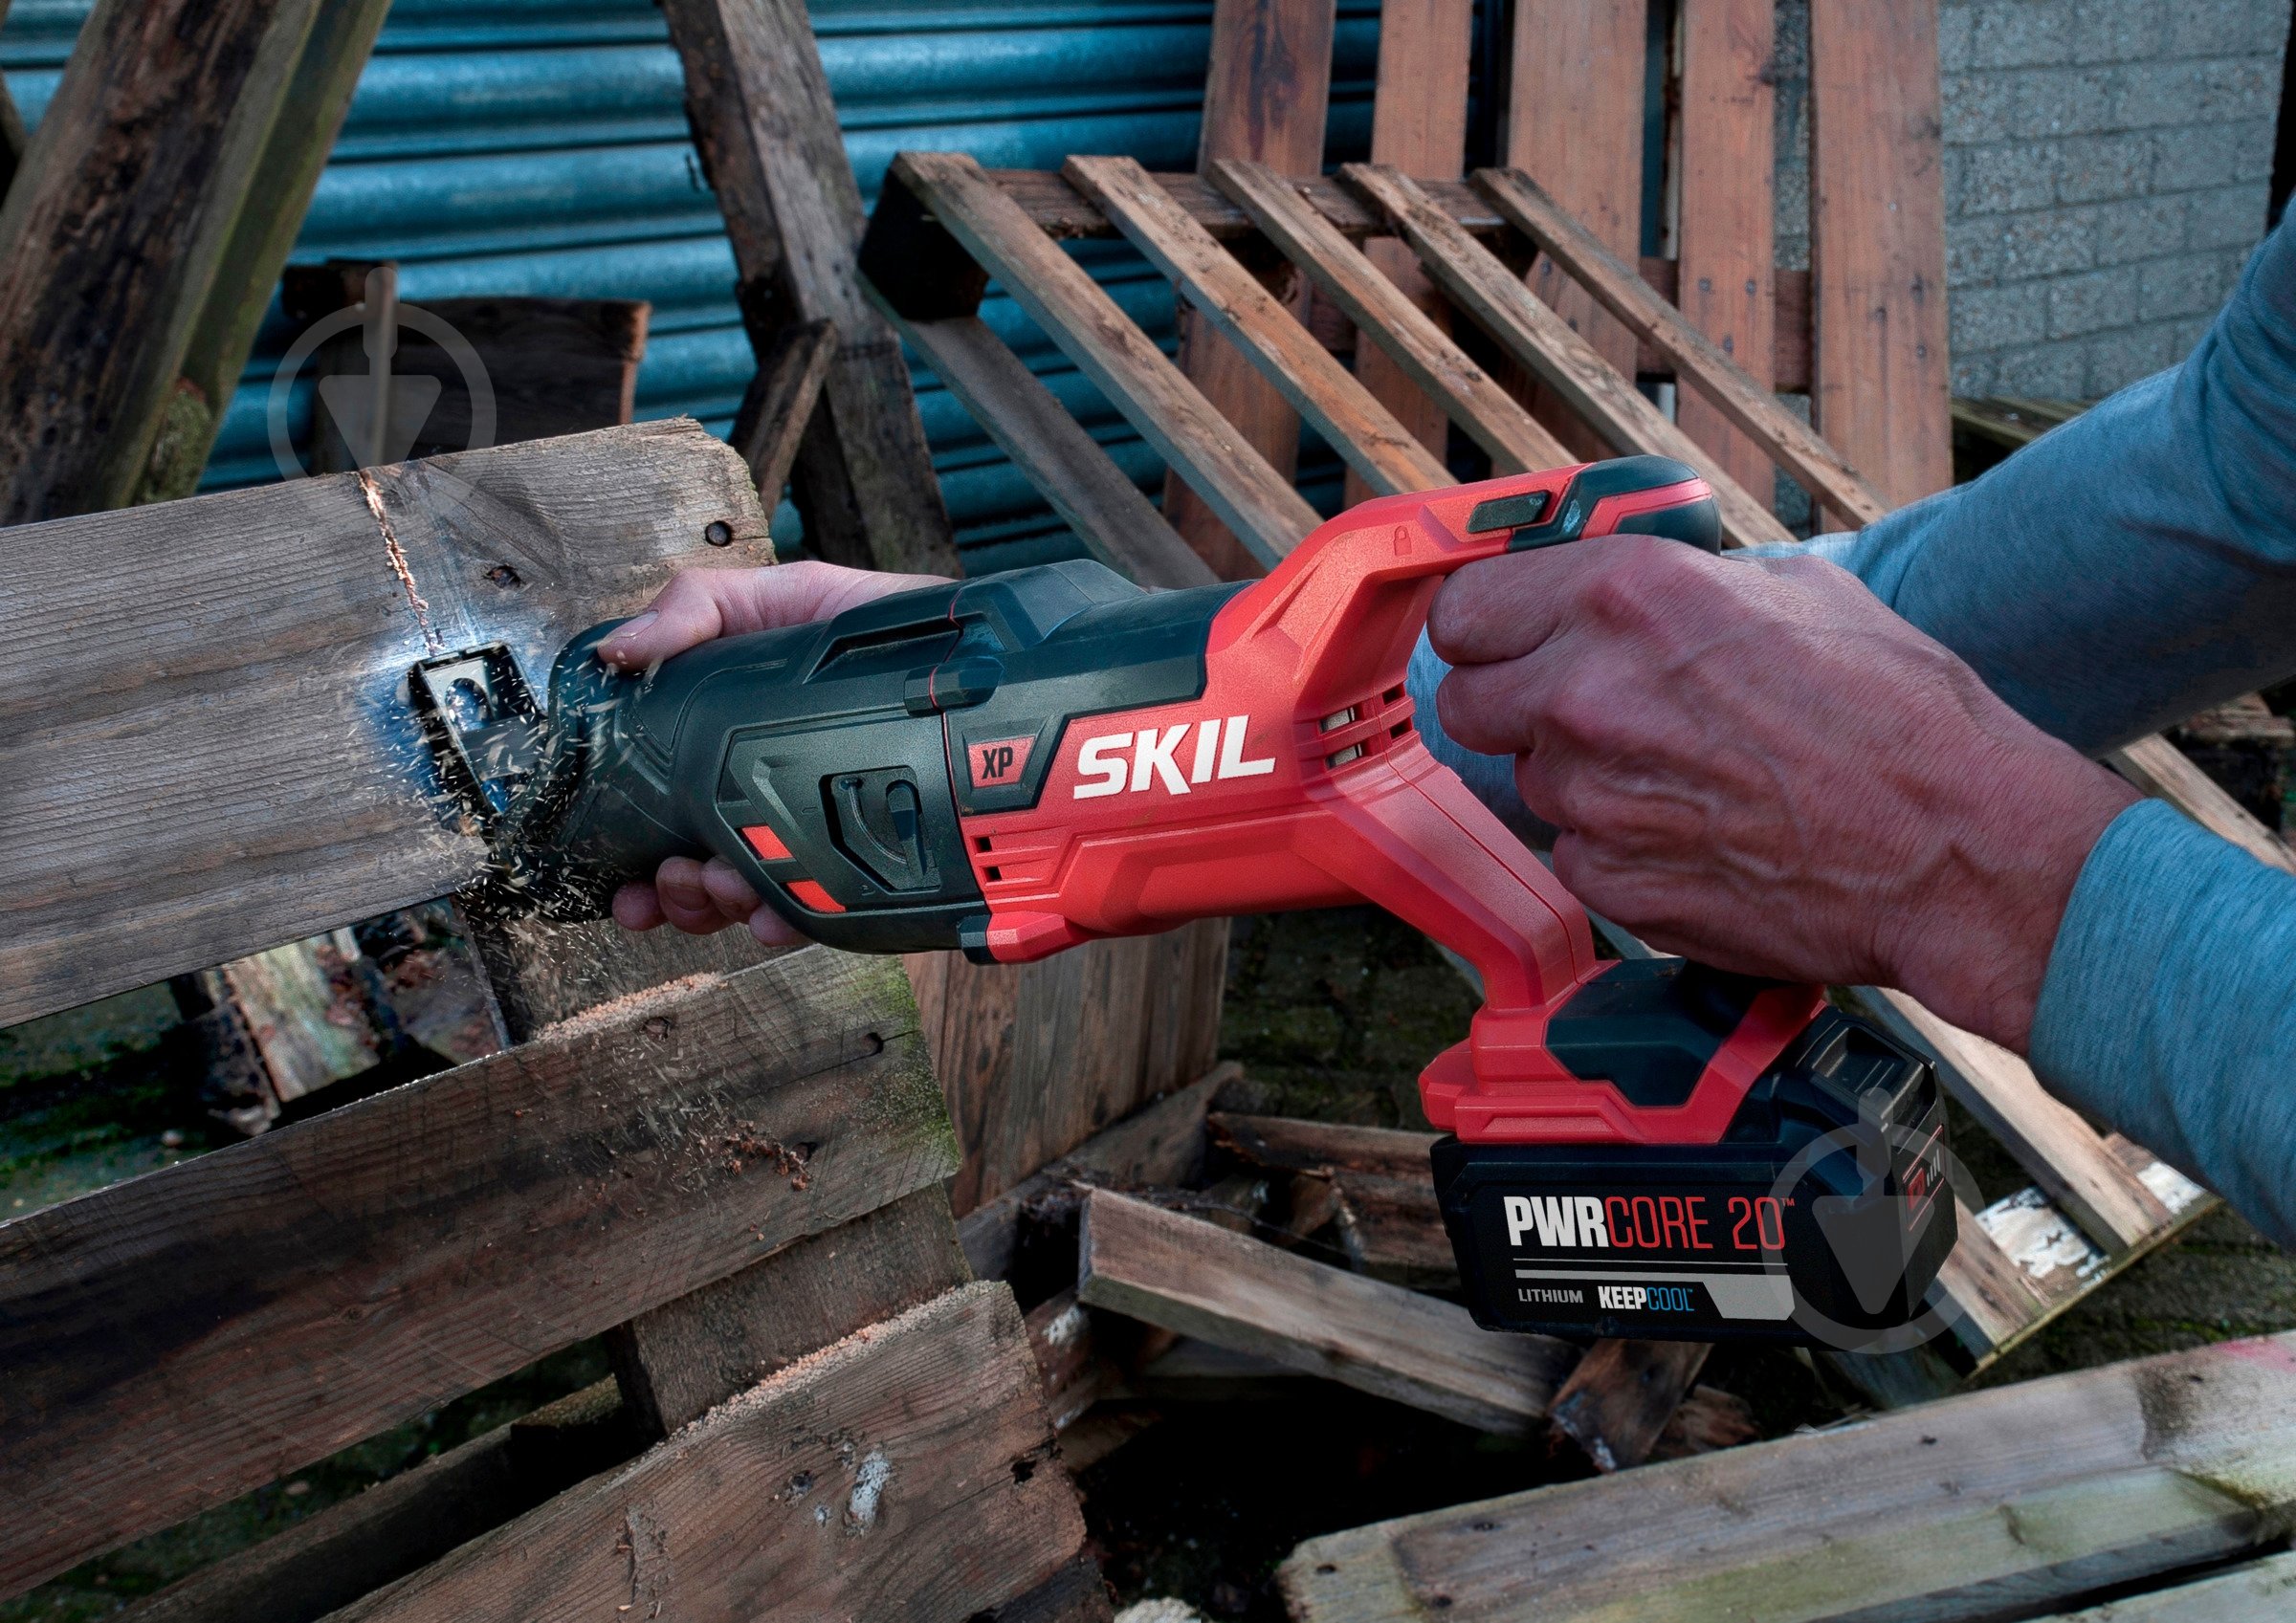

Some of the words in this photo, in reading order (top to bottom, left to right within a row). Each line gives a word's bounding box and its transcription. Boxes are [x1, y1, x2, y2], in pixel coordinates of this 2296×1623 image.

[982, 746, 1014, 779] XP
[1073, 714, 1276, 800] SKIL
[1503, 1195, 1713, 1249] PWRCORE
[1517, 1288, 1584, 1304] LITHIUM
